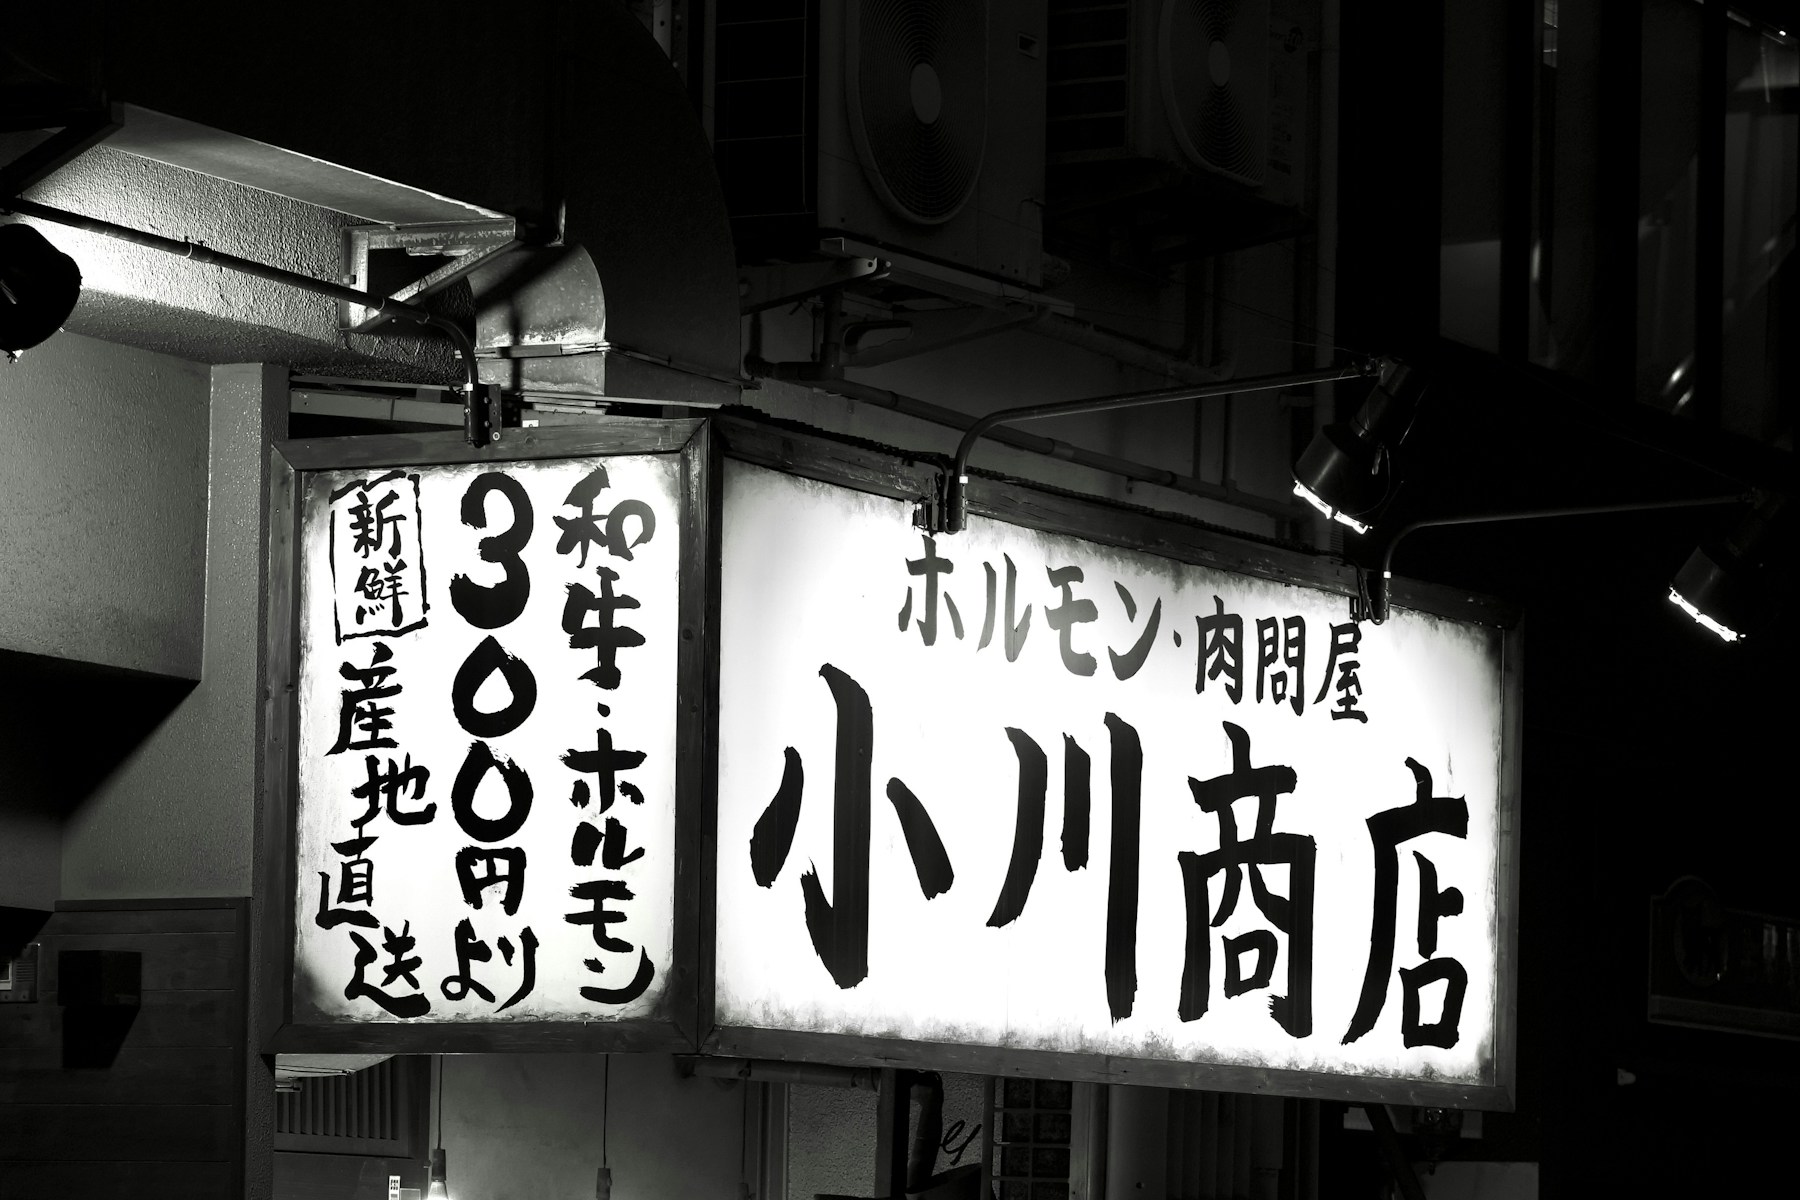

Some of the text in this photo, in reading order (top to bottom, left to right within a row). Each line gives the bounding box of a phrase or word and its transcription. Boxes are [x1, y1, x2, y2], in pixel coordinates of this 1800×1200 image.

[350, 489, 401, 628] 新鮮
[552, 464, 656, 1005] 和牛・ホルモン
[898, 533, 1370, 725] ホルモン・肉問屋
[315, 641, 437, 1018] 産地直送
[749, 662, 1470, 1050] 小川商店
